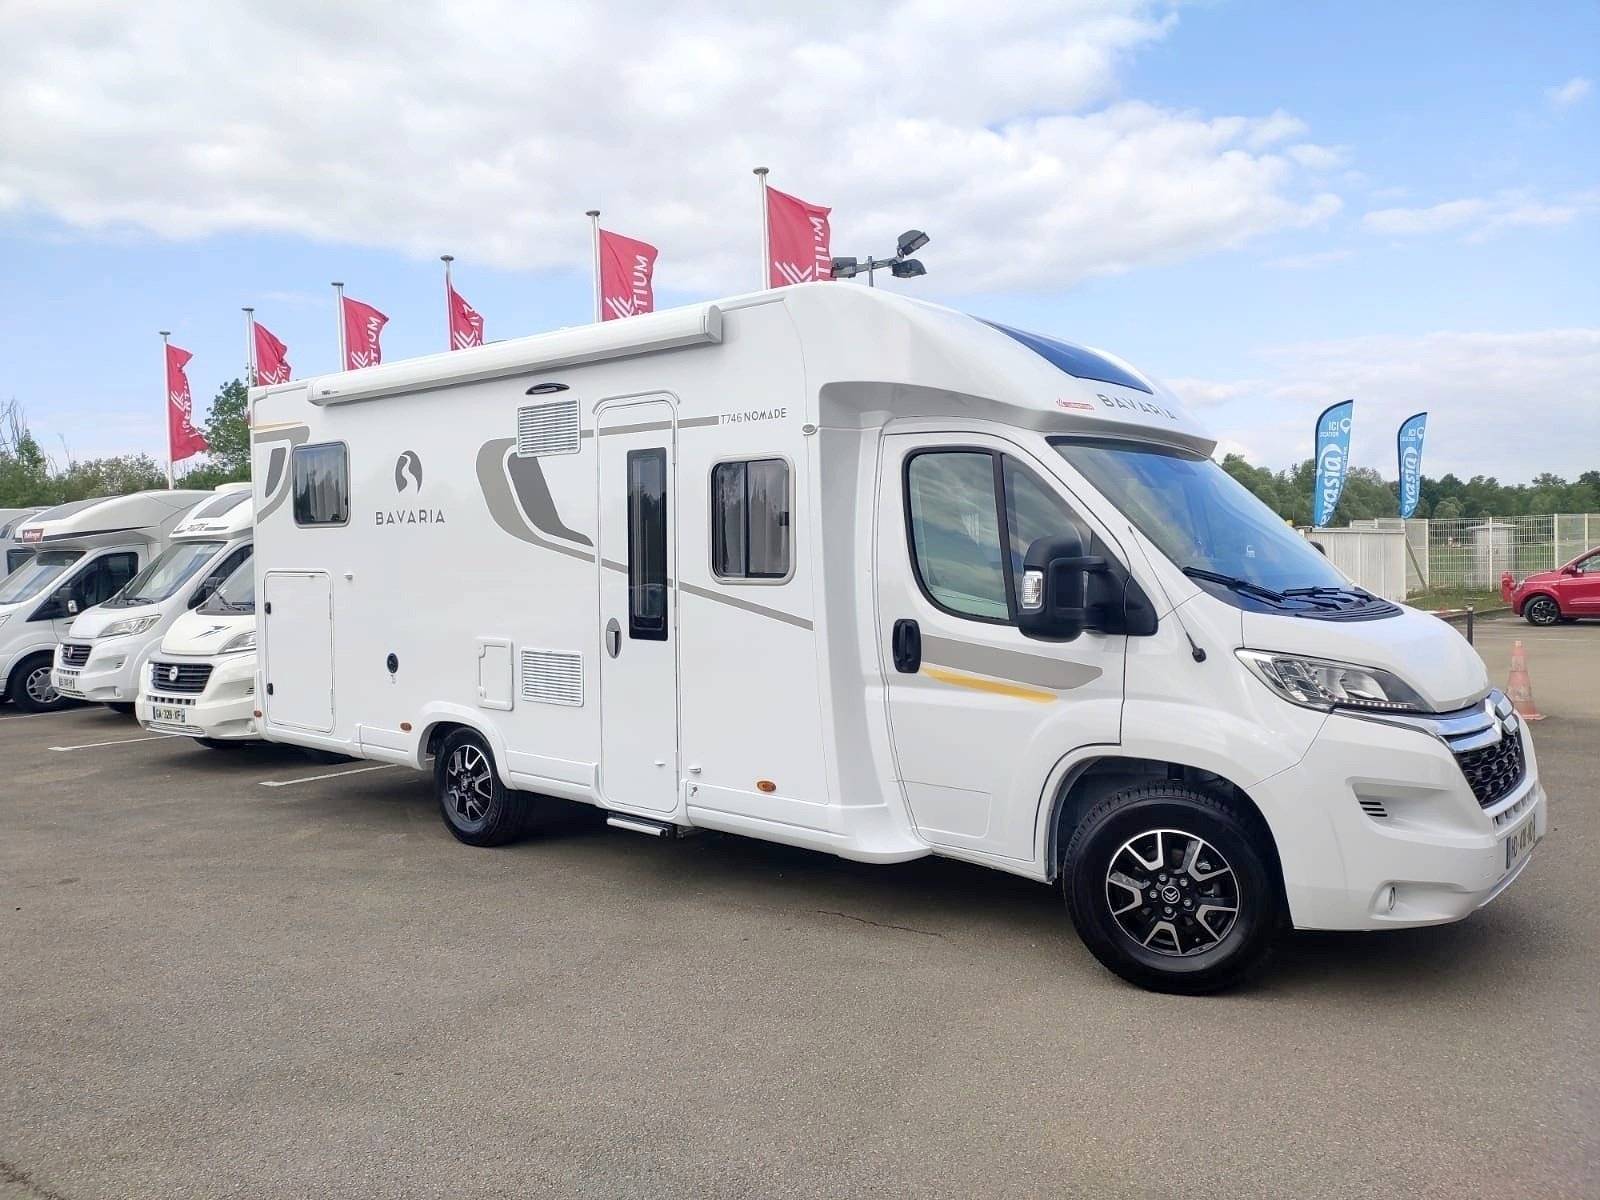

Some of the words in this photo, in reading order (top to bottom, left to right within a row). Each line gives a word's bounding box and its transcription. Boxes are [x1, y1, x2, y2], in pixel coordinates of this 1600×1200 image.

[808, 216, 831, 281] TIUM
[721, 412, 742, 424] T746
[744, 407, 787, 422] NOMADE
[1096, 393, 1178, 420] BAVARIA
[375, 509, 446, 526] BAVARIA
